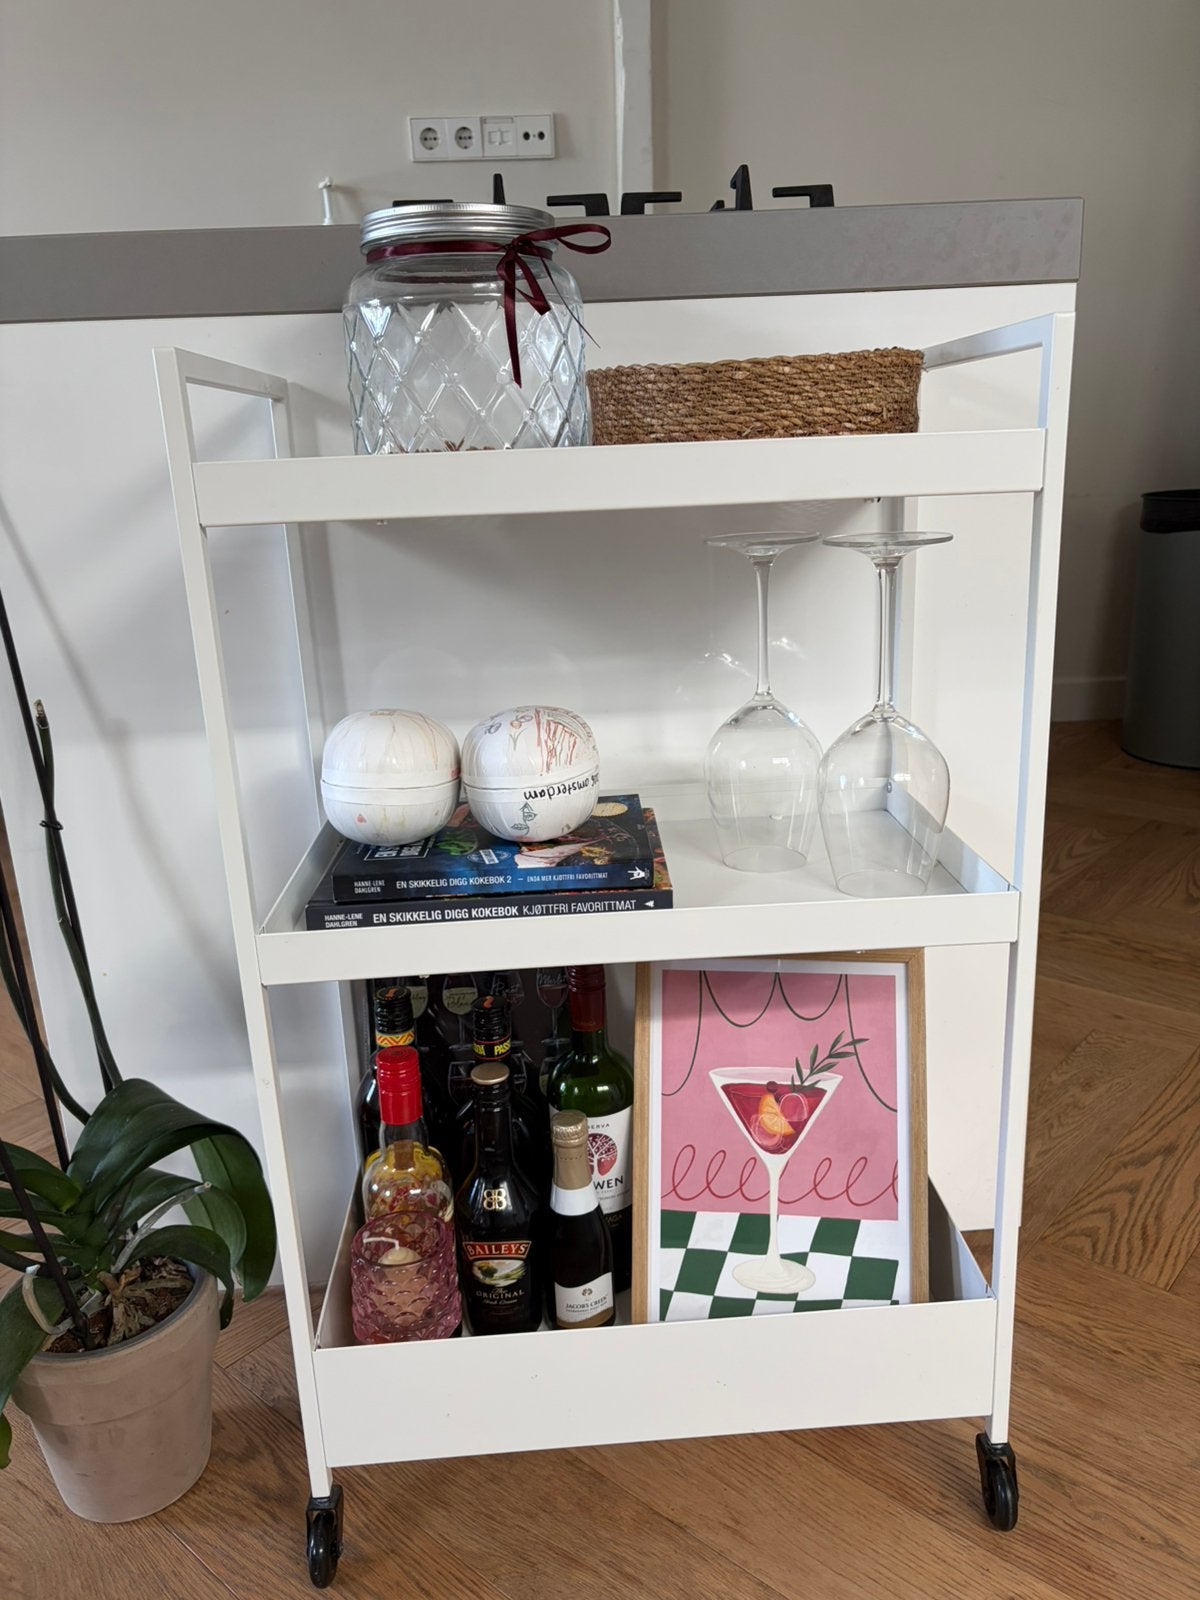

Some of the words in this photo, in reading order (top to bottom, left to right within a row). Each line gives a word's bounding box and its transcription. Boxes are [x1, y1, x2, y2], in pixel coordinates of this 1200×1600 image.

[523, 777, 590, 800] amsterdam
[396, 881, 407, 889] EN
[408, 879, 448, 889] SKIKKELIG
[449, 878, 468, 886] DIGG
[469, 876, 505, 885] KOKEBOK
[506, 876, 512, 884] 2
[324, 913, 363, 921] HANNE-LENE
[373, 913, 387, 924] EN
[389, 911, 442, 923] SKIKKELIG
[444, 909, 469, 920] DIGG
[471, 906, 519, 919] KOKEBOK
[522, 902, 568, 915] KJØTTFRI
[571, 900, 637, 913] FAVORITTMAT
[325, 920, 358, 928] DAHLGREN
[467, 1244, 527, 1255] BAILEYS
[476, 1290, 525, 1299] ORIGINAL
